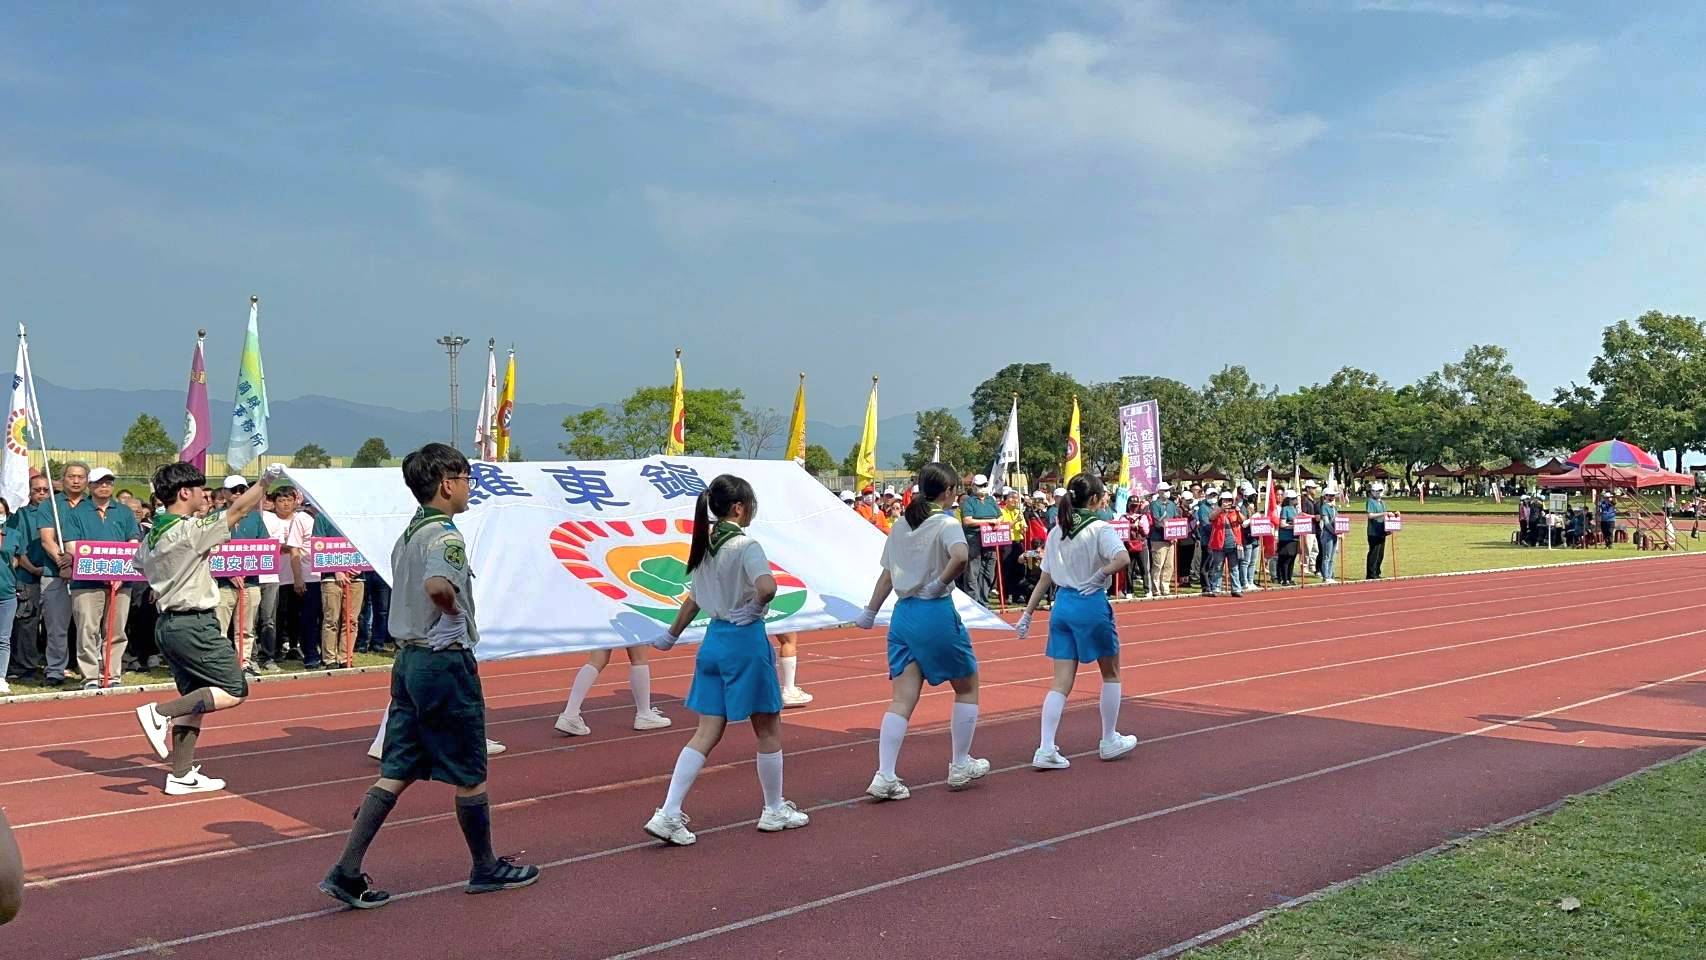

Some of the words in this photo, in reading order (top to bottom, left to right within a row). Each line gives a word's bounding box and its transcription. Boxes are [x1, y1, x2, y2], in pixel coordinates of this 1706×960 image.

[468, 460, 709, 511] 羅東鎮
[210, 554, 274, 571] 維安社區
